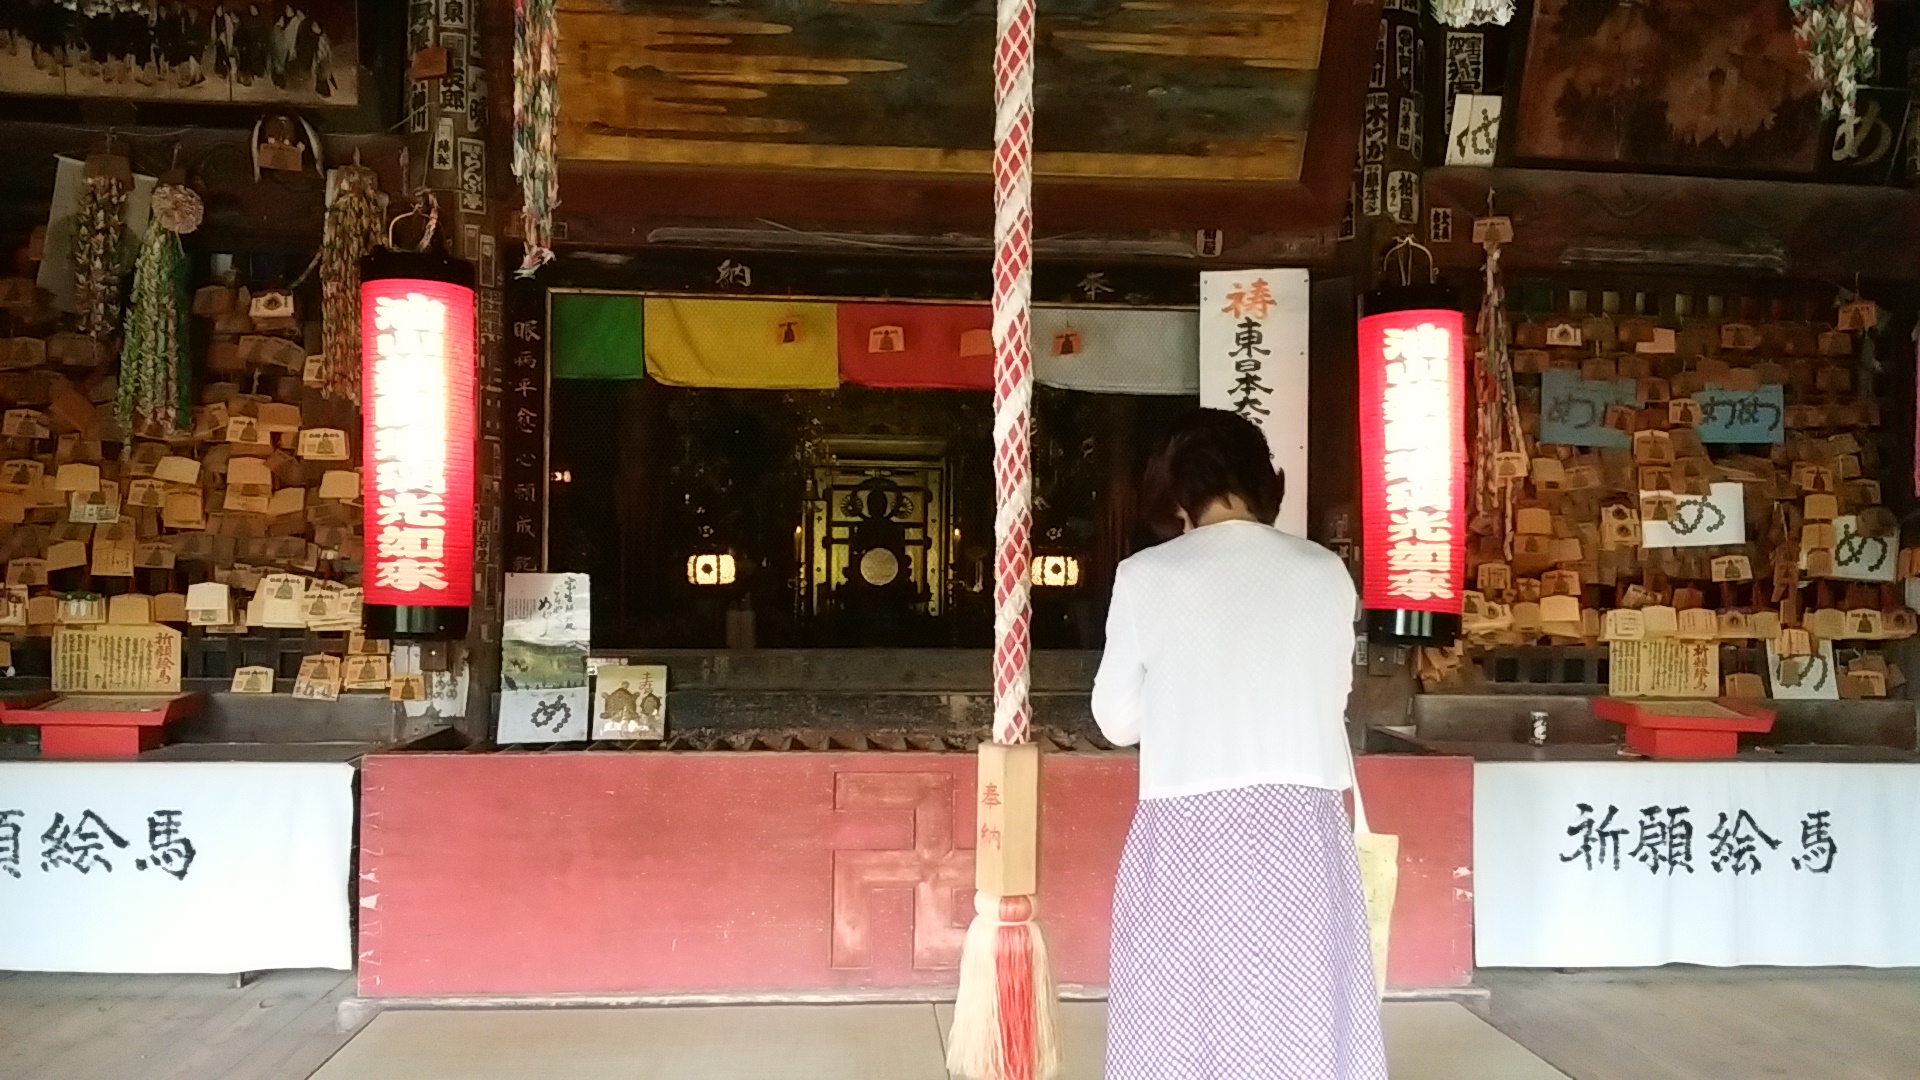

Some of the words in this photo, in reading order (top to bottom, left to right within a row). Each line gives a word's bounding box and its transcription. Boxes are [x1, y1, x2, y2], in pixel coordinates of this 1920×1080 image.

[715, 259, 751, 289] 納
[980, 782, 1002, 850] 奉納
[1560, 803, 1838, 876] 祈願絵馬
